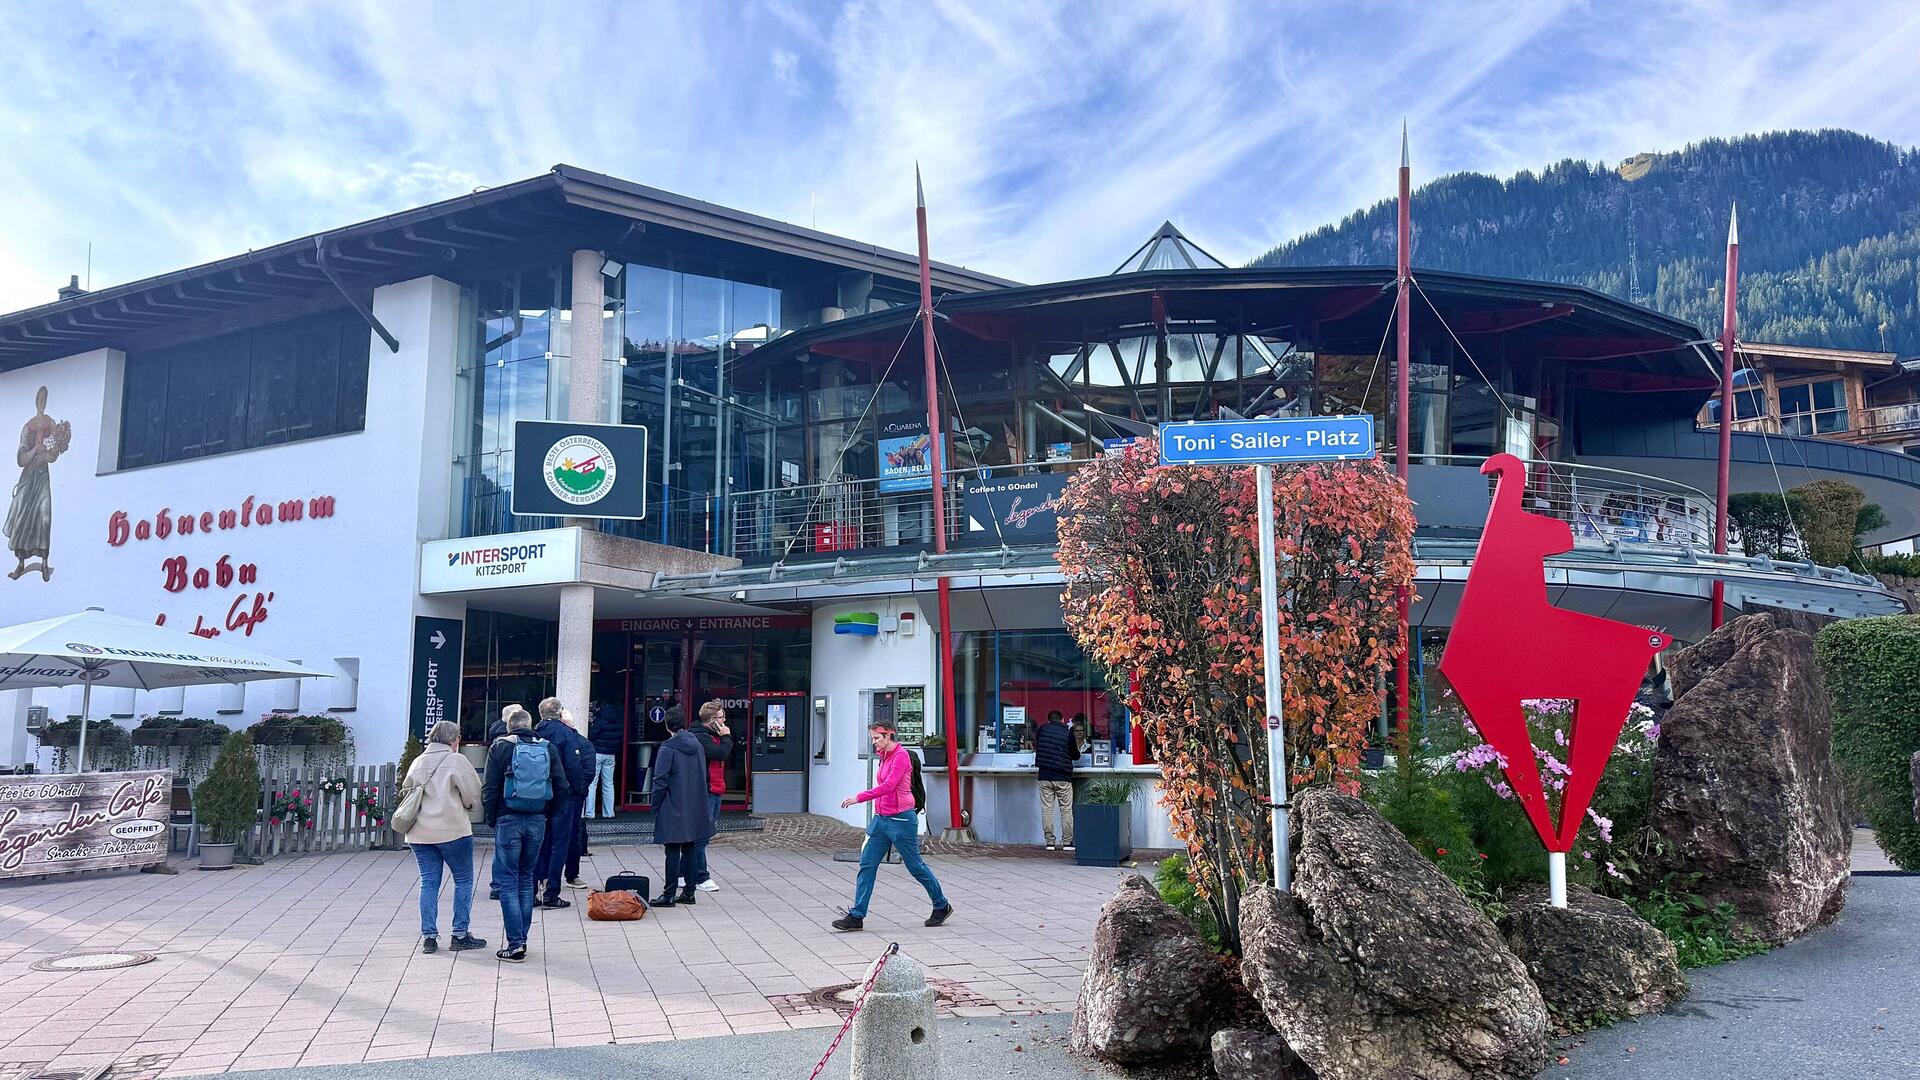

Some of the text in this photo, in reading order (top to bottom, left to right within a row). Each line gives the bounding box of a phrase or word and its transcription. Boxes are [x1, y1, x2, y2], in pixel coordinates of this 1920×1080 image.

[883, 422, 922, 433] AQUARENA
[969, 485, 996, 494] Coffee
[461, 543, 546, 566] INTERSPORT
[161, 554, 257, 593] Bahn
[475, 562, 527, 576] KITZSPORT
[225, 591, 274, 637] Café
[621, 617, 770, 632] EINGANG ENTRANCE
[103, 647, 208, 663] ERDINGER
[23, 787, 36, 798] to
[40, 783, 85, 798] GOndel
[108, 777, 163, 818] Café
[46, 844, 89, 861] Snacks
[102, 841, 128, 855] Take
[129, 841, 158, 854] away
